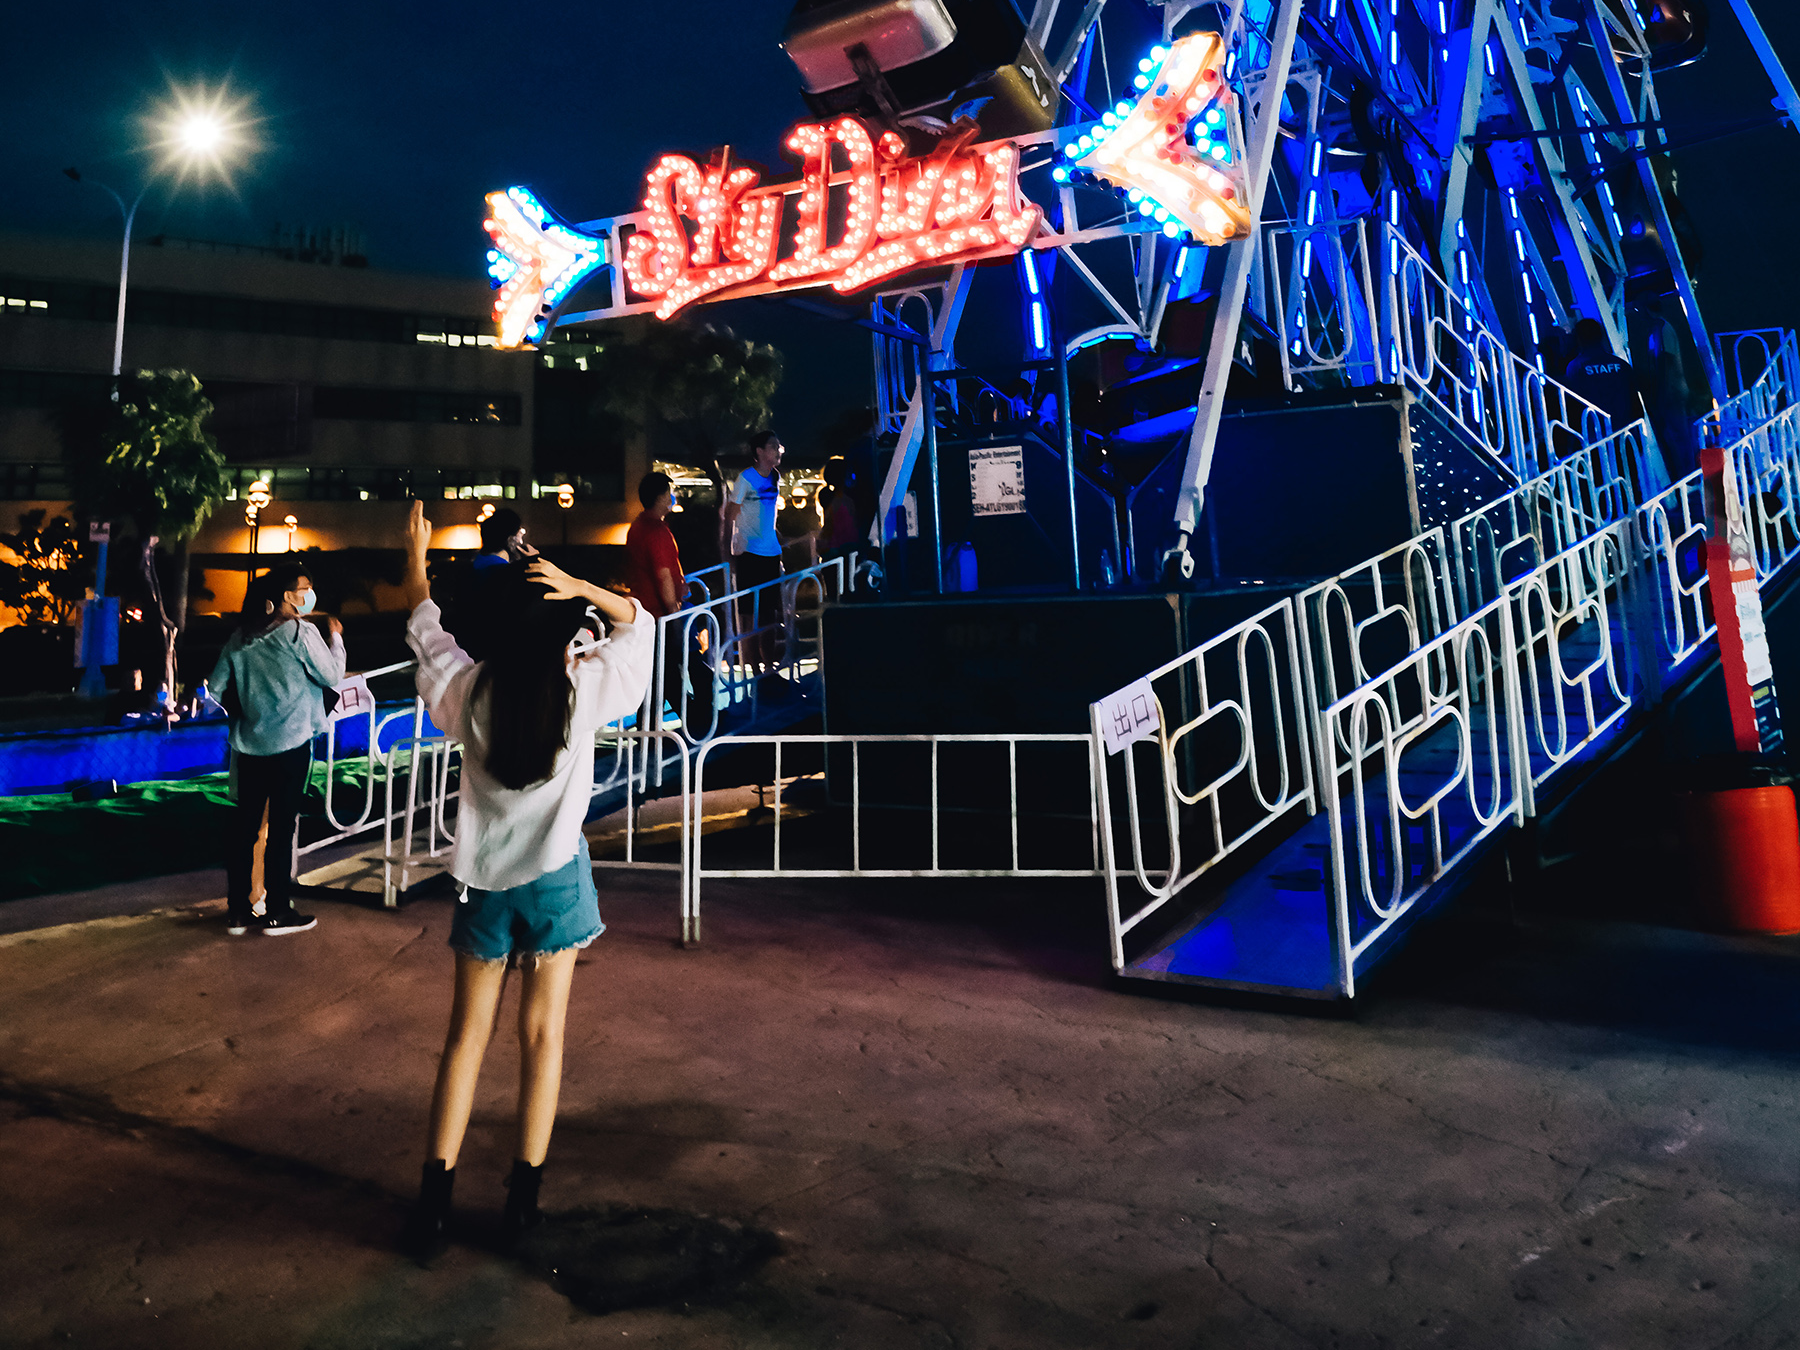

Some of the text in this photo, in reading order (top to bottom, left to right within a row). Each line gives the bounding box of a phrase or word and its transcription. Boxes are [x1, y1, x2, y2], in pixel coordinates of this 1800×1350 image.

[622, 116, 1042, 321] Sky Diver
[1585, 363, 1621, 376] STAFF
[1112, 693, 1151, 742] 出口
